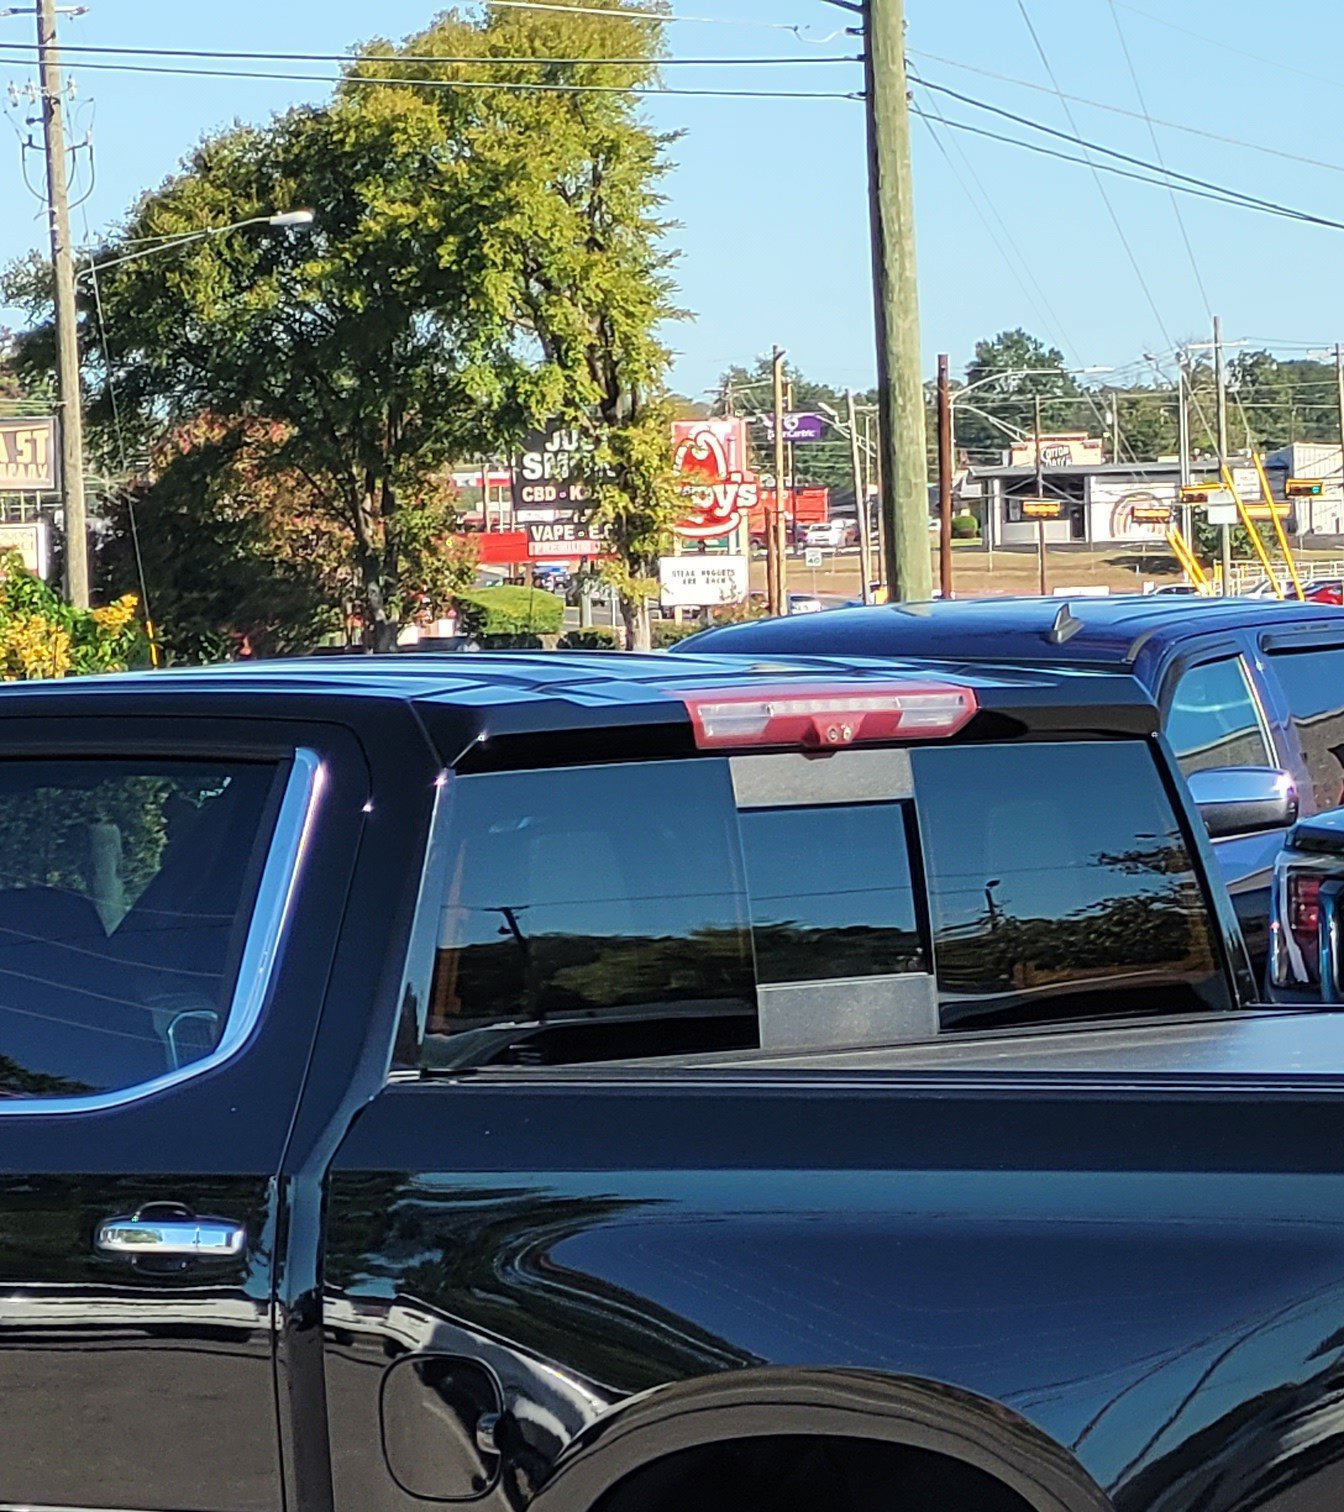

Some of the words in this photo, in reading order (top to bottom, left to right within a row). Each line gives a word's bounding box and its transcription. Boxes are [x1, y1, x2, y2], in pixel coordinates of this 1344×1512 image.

[16, 429, 49, 464] ST
[522, 486, 556, 502] CBD
[531, 524, 575, 541] VAPE
